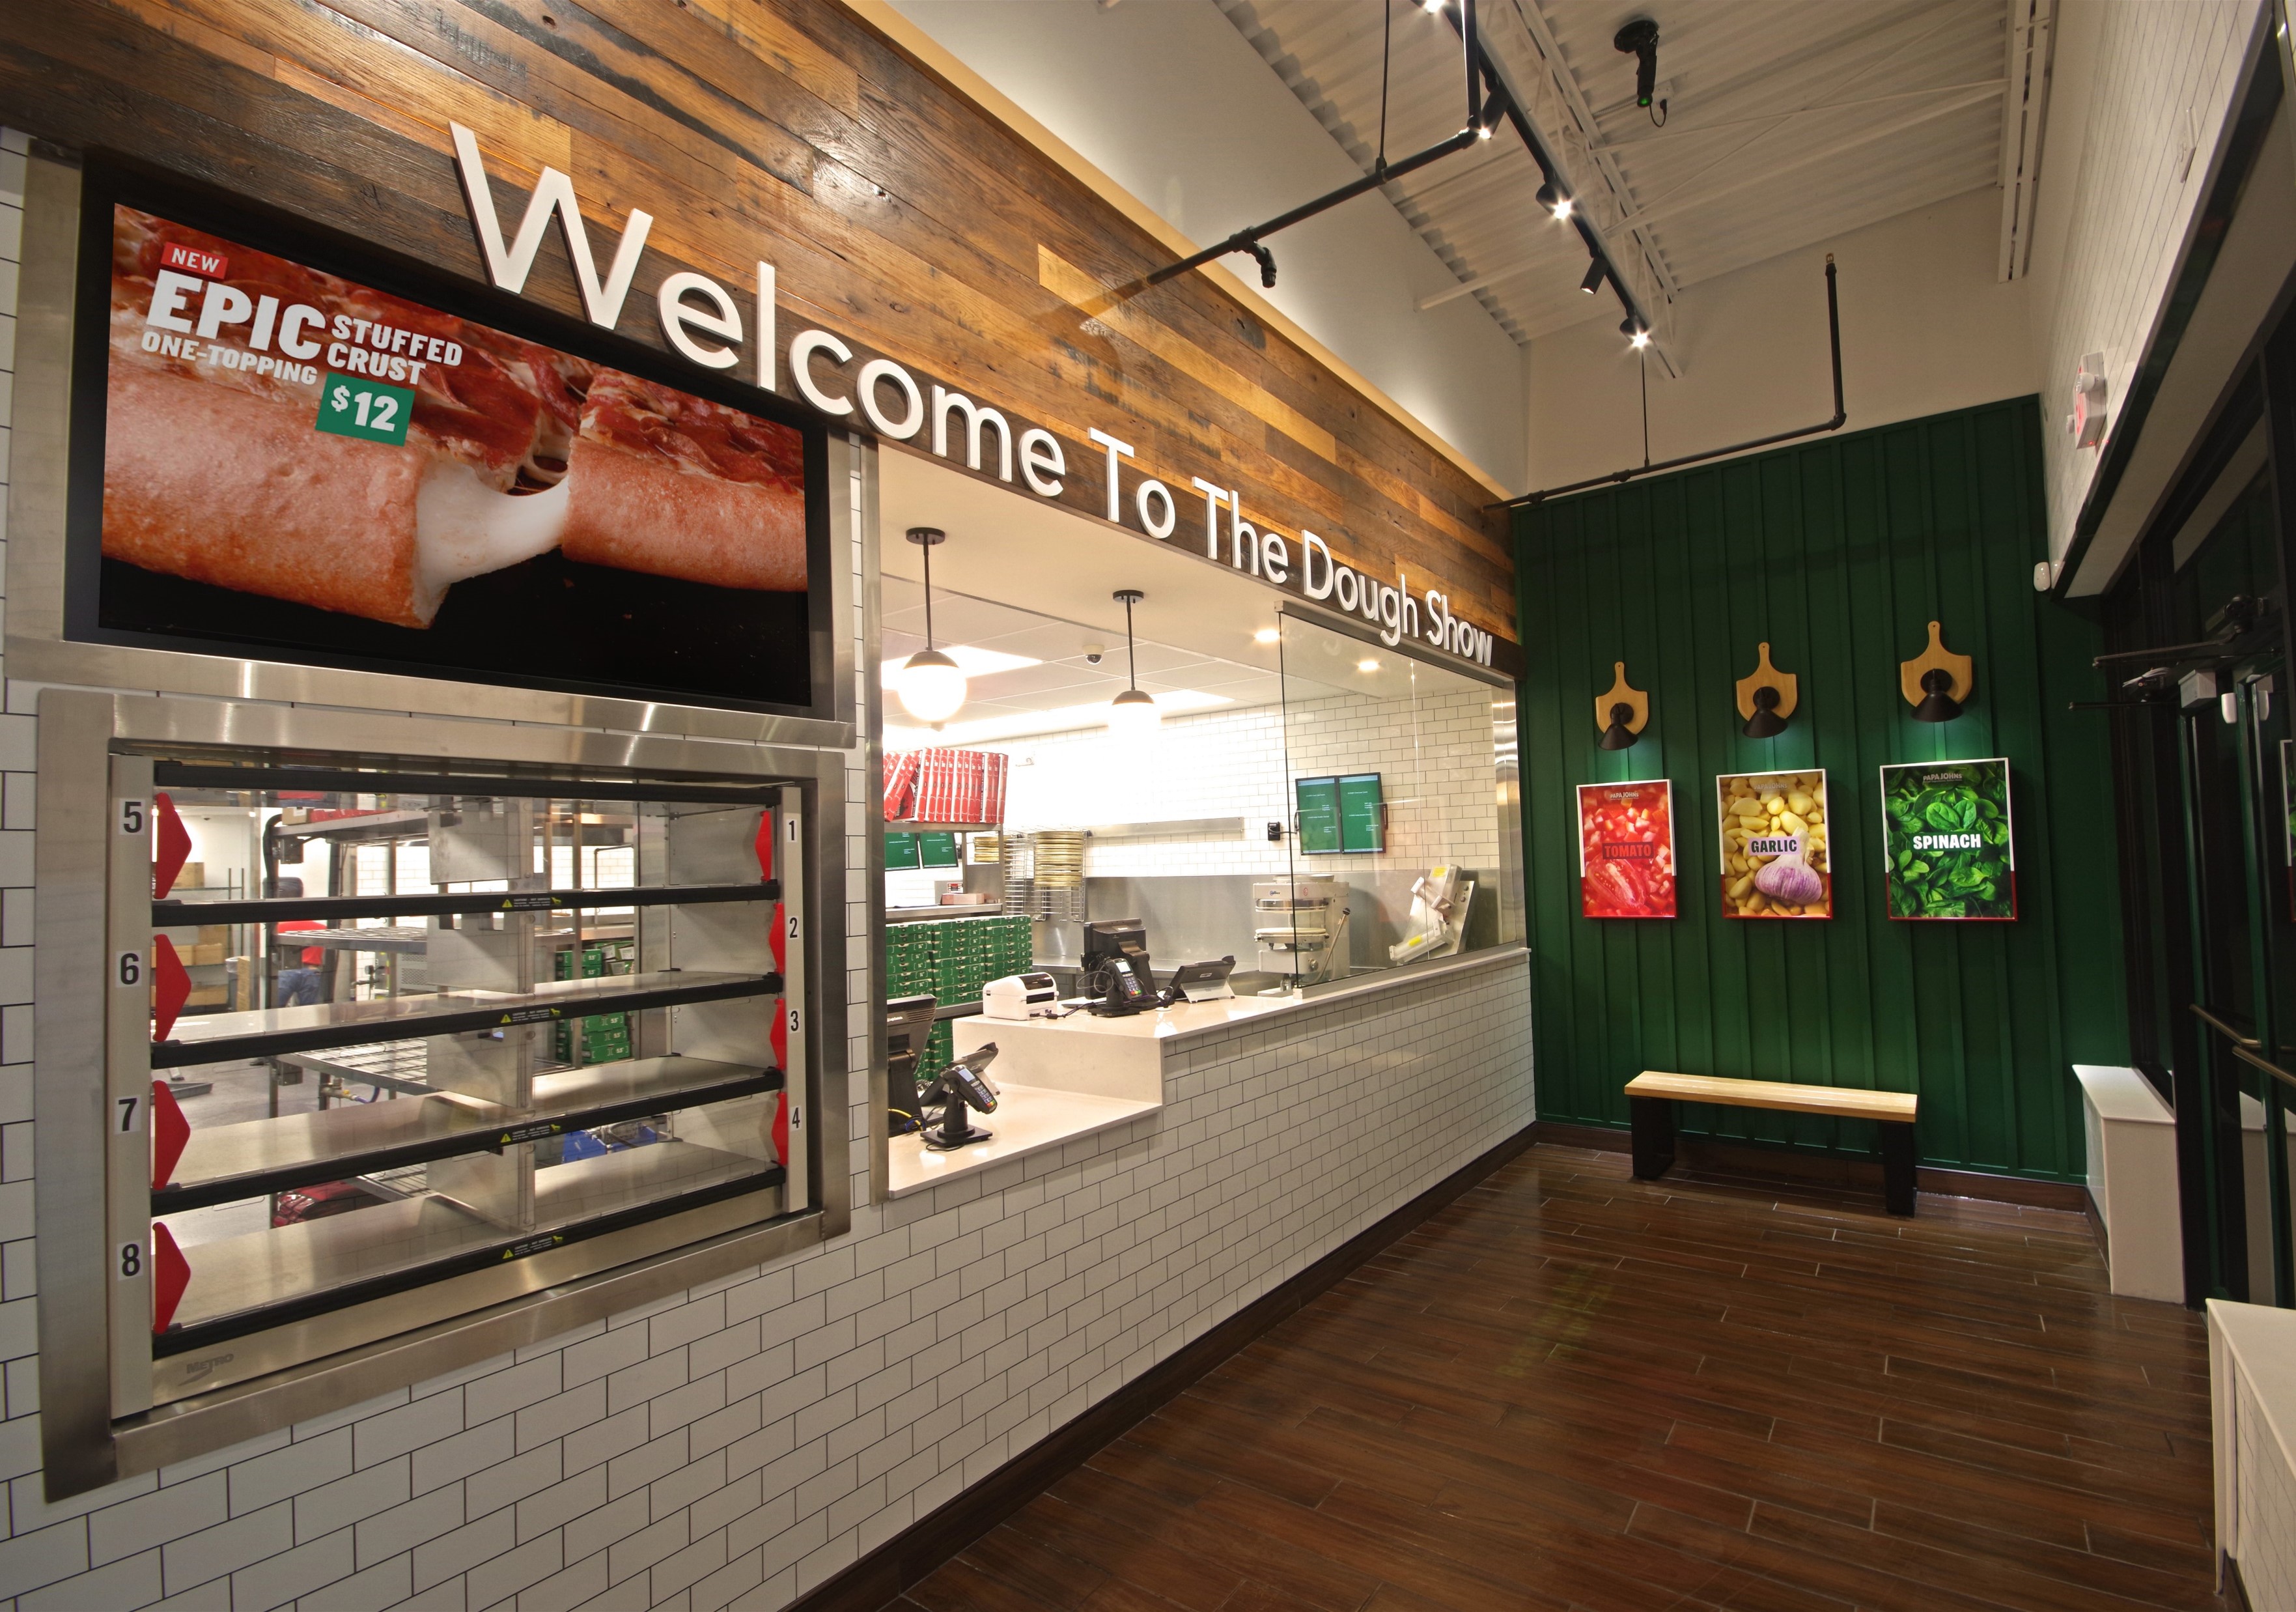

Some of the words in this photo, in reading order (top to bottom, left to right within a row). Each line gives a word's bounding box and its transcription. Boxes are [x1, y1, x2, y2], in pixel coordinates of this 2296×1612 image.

[171, 247, 221, 274] NEW
[146, 268, 326, 361] EPIC
[331, 315, 463, 367] STUFFED
[141, 331, 318, 386] ONE-TOPPING
[326, 342, 427, 386] CRUST
[330, 384, 399, 432] $12
[448, 120, 1067, 498] Welcome
[1087, 426, 1176, 539] To
[1191, 475, 1289, 584] The
[1301, 528, 1419, 647] Dough
[1425, 589, 1493, 667] Show
[123, 800, 142, 834] 5
[788, 820, 796, 841] 1
[1604, 843, 1652, 858] TOMATO
[1750, 838, 1798, 853] GARLIC
[1912, 833, 1981, 850] SPINACH
[789, 917, 798, 939] 2
[120, 952, 139, 985] 6
[790, 1010, 800, 1032] 3
[118, 1097, 137, 1132] 7
[791, 1107, 800, 1129] 4
[120, 1243, 141, 1277] 8
